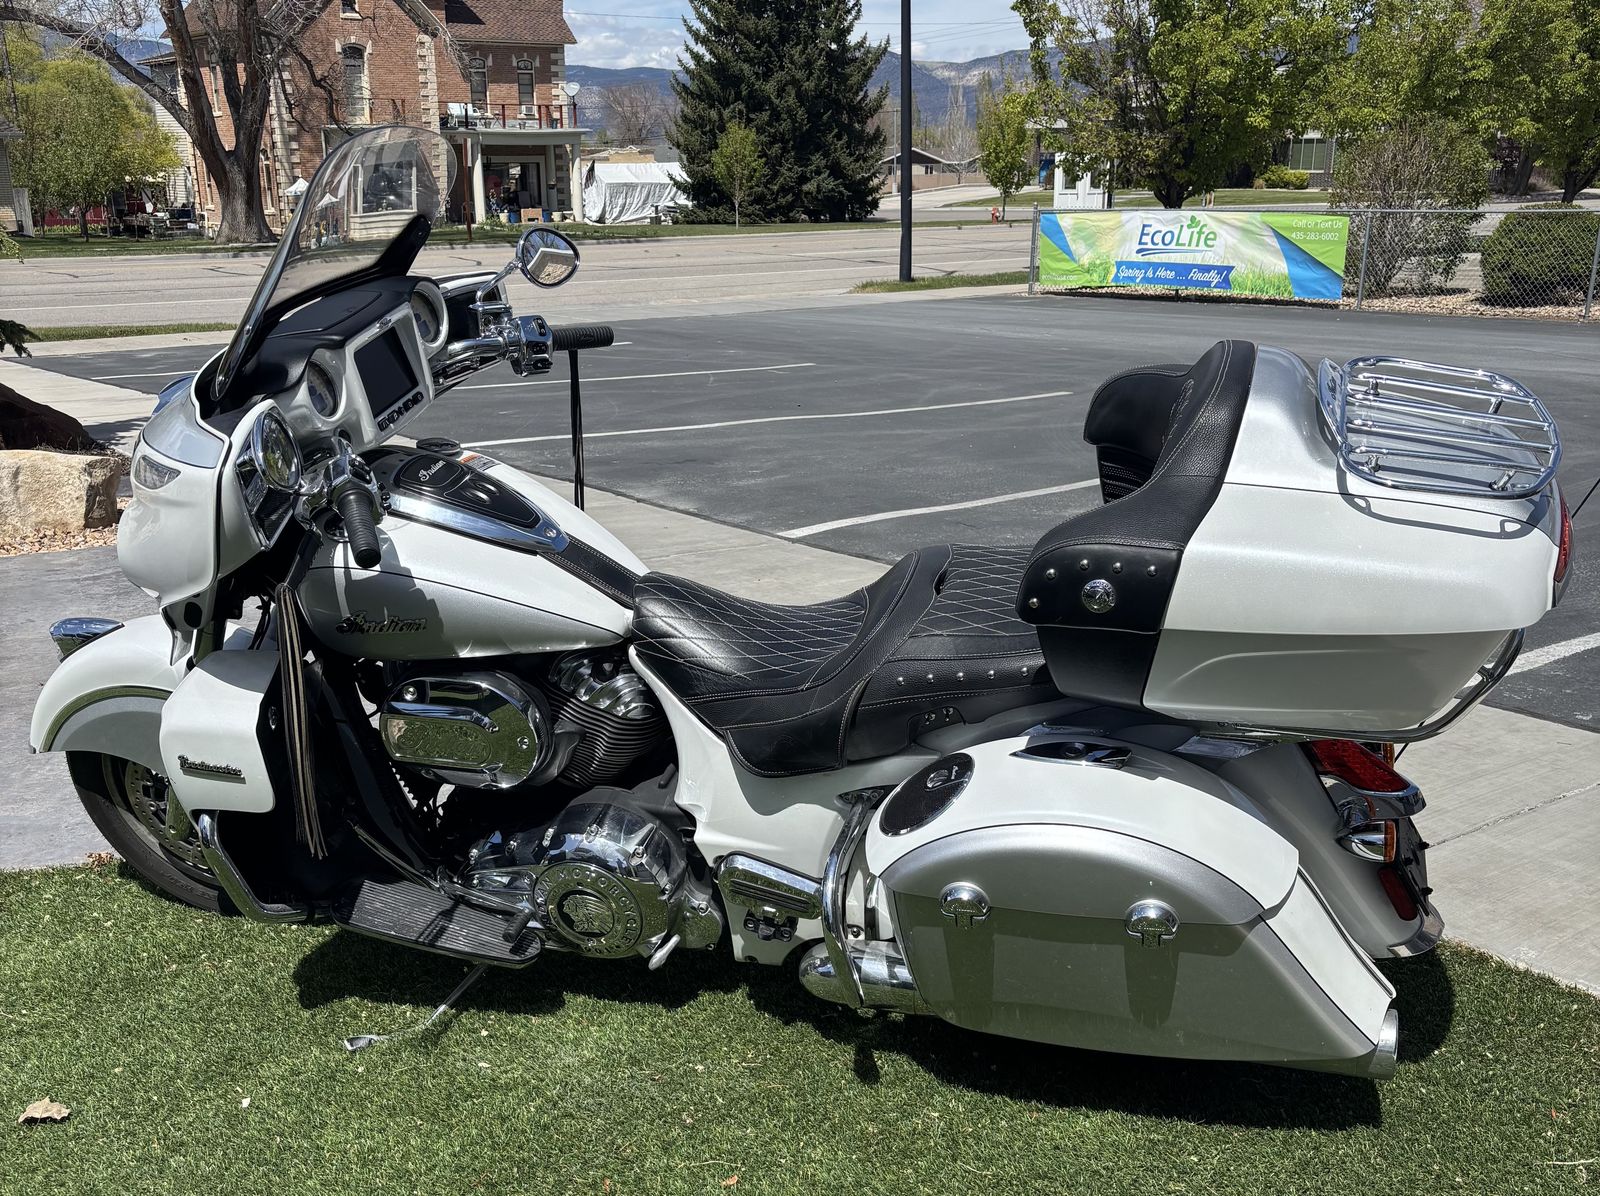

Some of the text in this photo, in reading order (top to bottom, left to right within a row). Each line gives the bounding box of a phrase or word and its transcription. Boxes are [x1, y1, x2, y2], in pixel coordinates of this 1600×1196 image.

[1138, 222, 1217, 248] EcoLife
[1292, 219, 1306, 228] Call
[1317, 220, 1331, 228] Text
[1333, 220, 1343, 229] Us
[1291, 231, 1339, 240] 435-283-6002
[1118, 265, 1145, 282] Spring
[1146, 266, 1153, 278] Is
[1155, 267, 1175, 279] Here
[1188, 268, 1227, 287] Finally!
[418, 460, 447, 482] Indian
[336, 610, 427, 634] Indian
[556, 867, 638, 946] MOTORCYCLE
